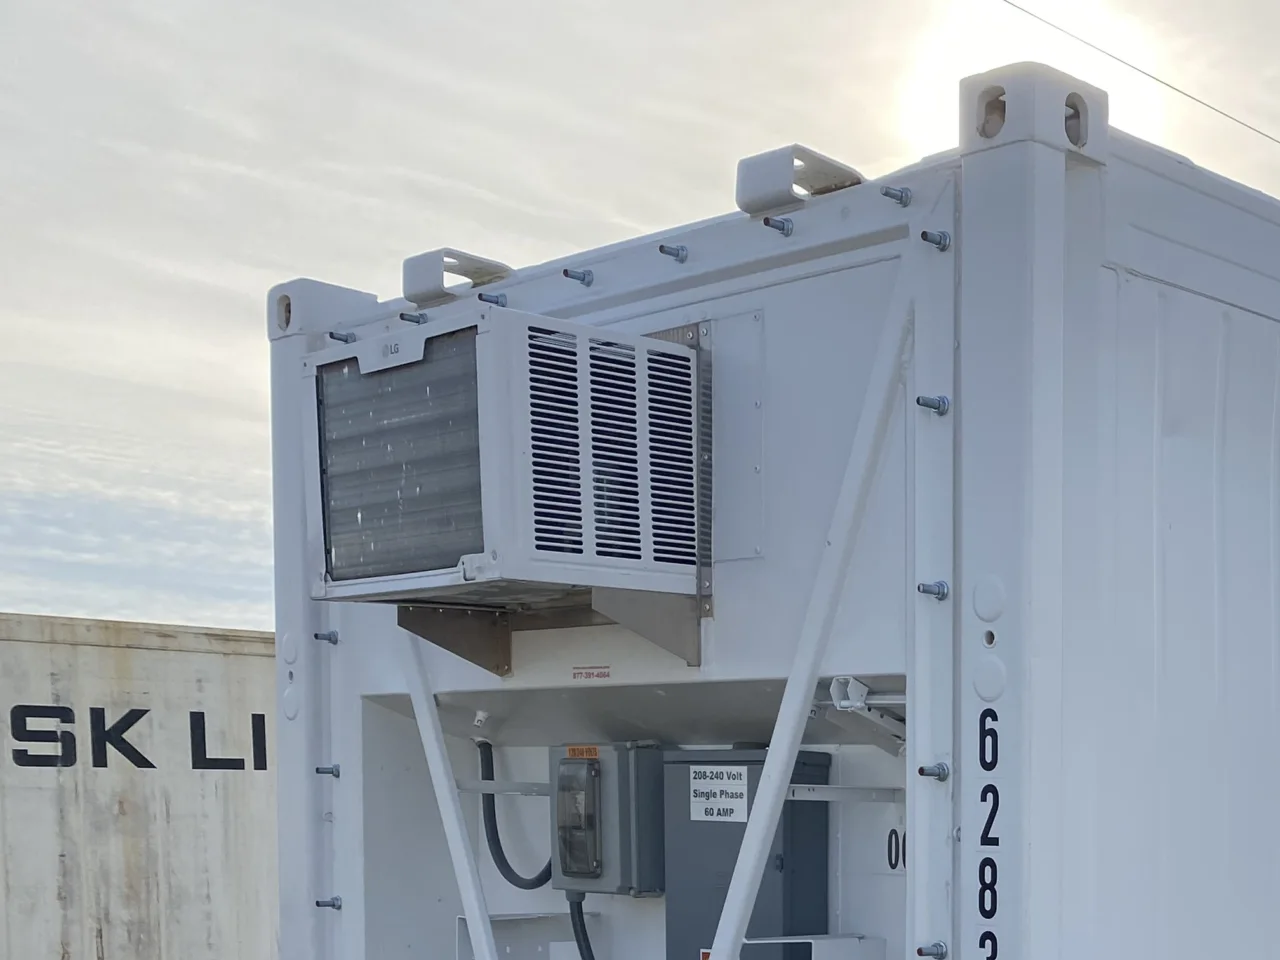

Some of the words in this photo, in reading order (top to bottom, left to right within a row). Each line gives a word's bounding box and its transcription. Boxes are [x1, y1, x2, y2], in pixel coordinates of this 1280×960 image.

[390, 343, 399, 355] LG
[10, 704, 157, 769] SK
[189, 711, 268, 771] LI
[692, 770, 724, 780] 208-240
[726, 771, 743, 781] Volt
[692, 788, 717, 801] Single
[719, 789, 744, 799] Phase
[704, 807, 714, 817] 60
[716, 807, 735, 817] AMP
